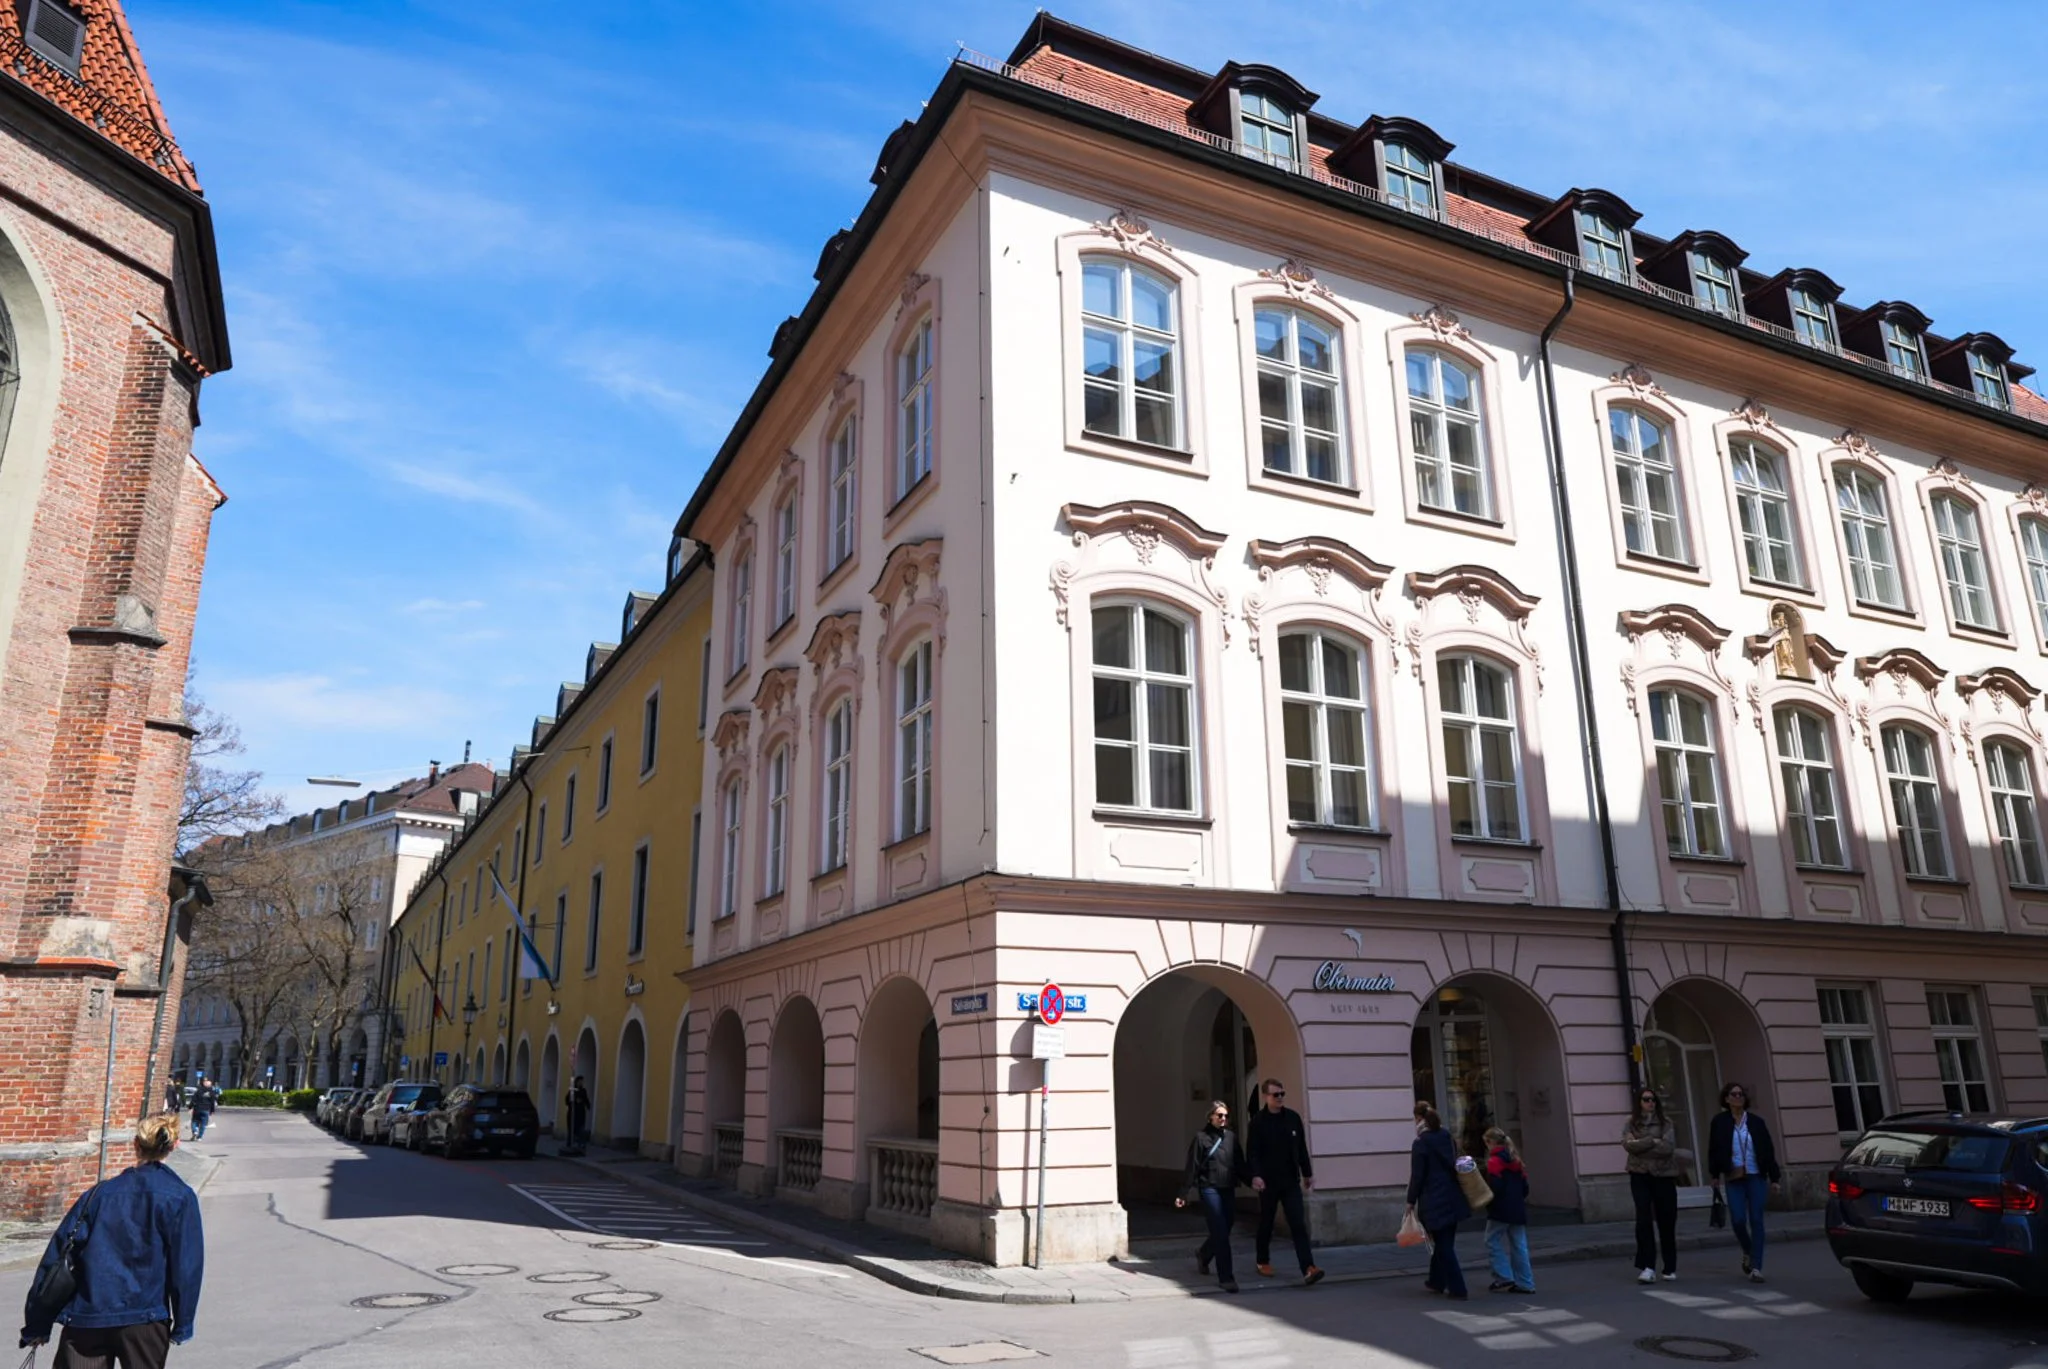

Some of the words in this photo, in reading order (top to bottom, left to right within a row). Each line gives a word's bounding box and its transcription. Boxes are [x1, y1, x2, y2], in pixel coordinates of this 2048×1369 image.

[1314, 960, 1396, 991] Obermaier
[1903, 1199, 1917, 1211] WF
[1920, 1201, 1948, 1214] 1933
